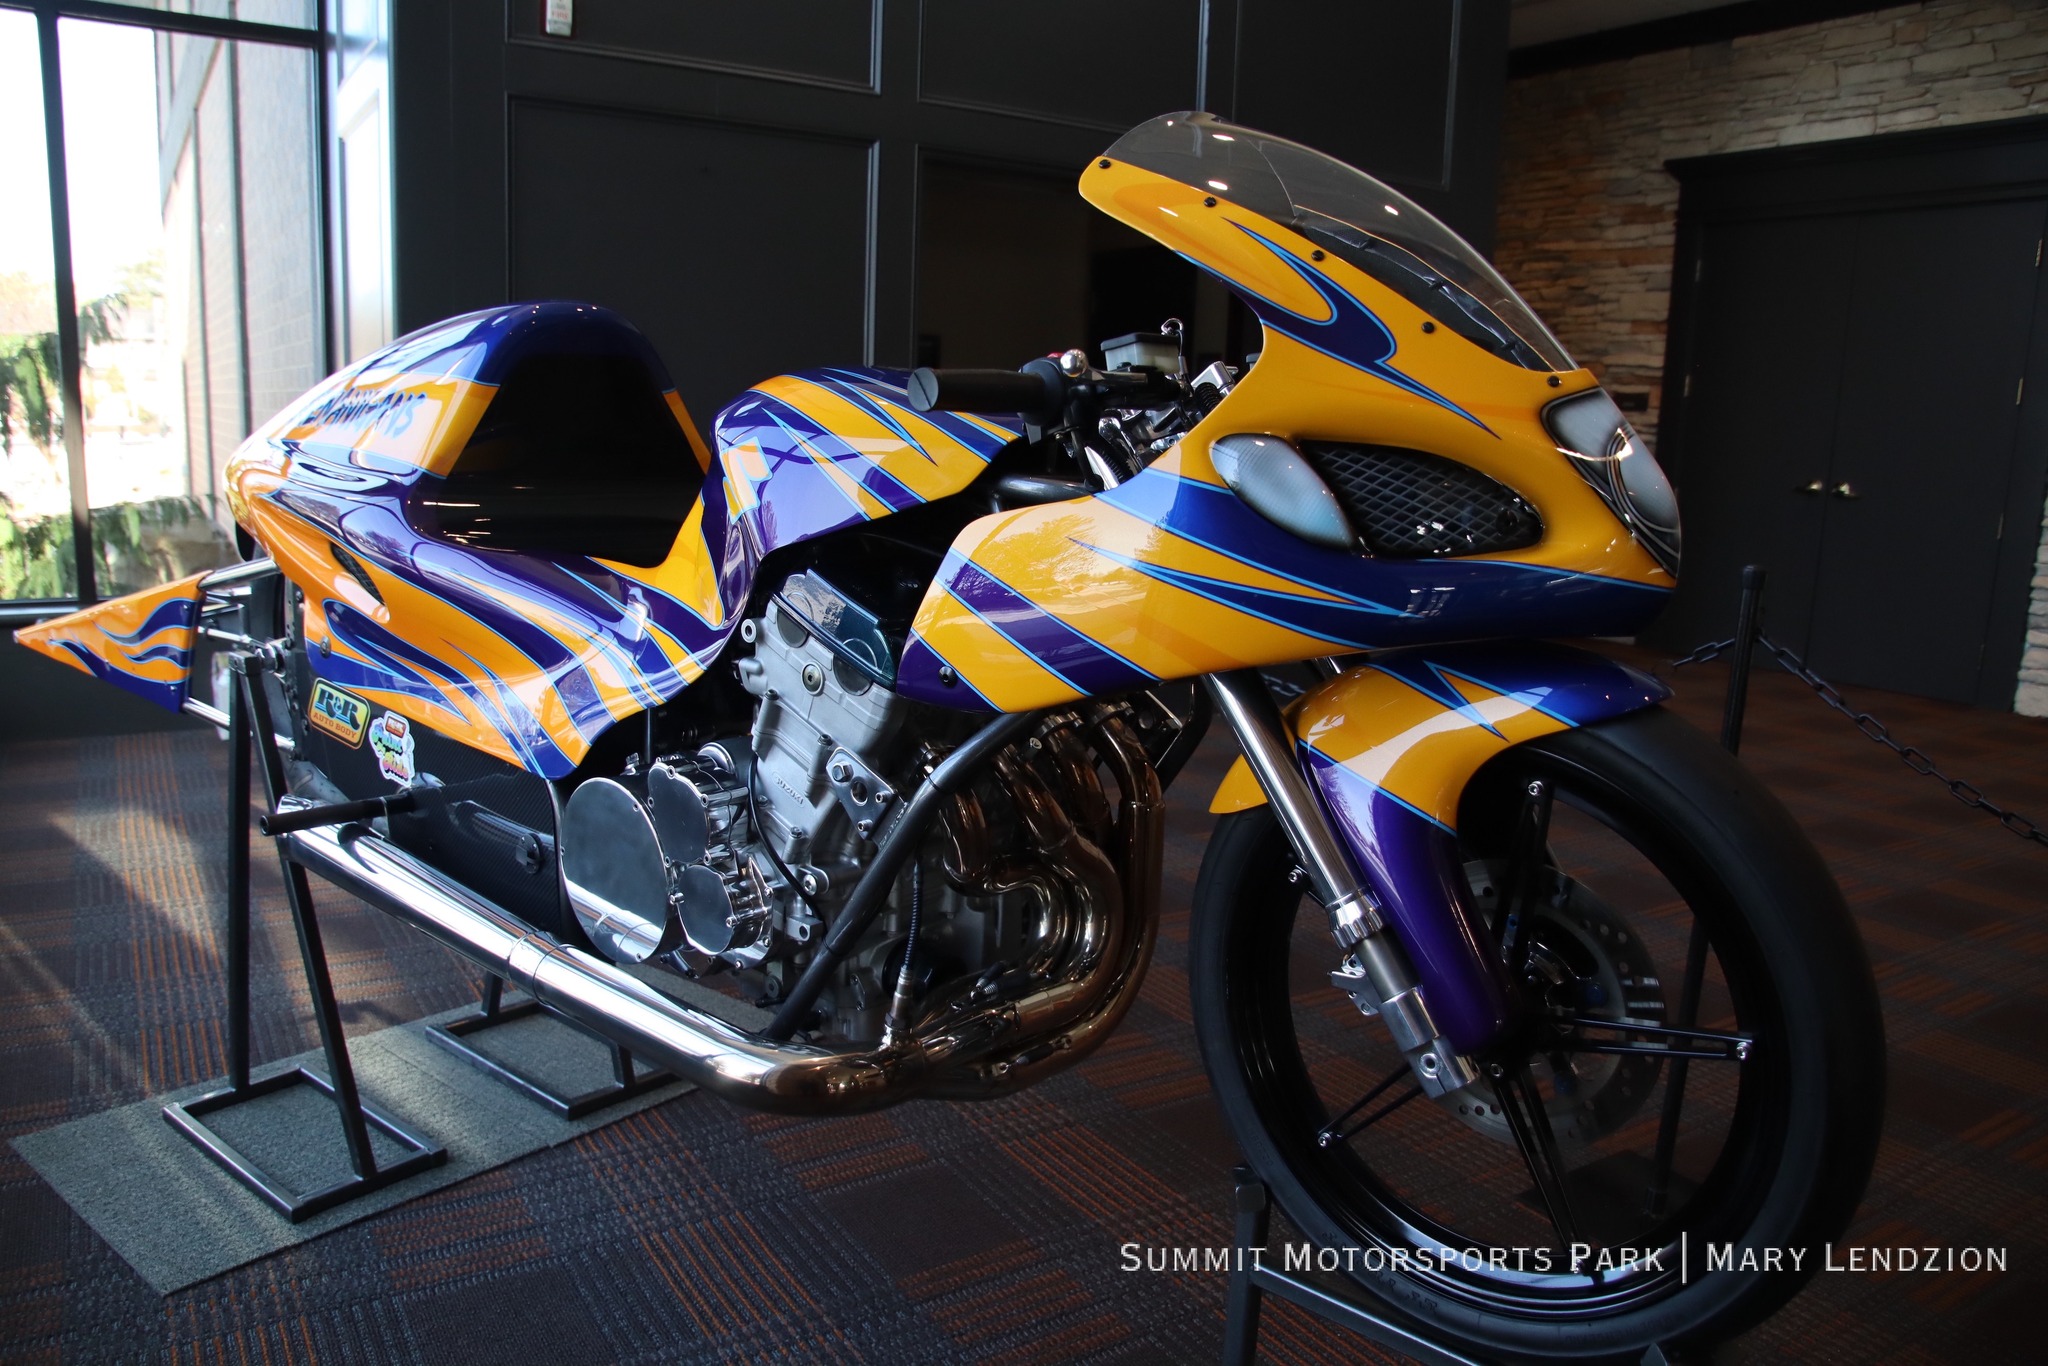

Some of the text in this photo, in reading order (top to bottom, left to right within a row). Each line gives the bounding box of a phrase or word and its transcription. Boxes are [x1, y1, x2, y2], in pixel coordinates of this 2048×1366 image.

[313, 712, 334, 726] AUTO
[335, 723, 357, 739] BODY
[318, 687, 361, 731] R&R
